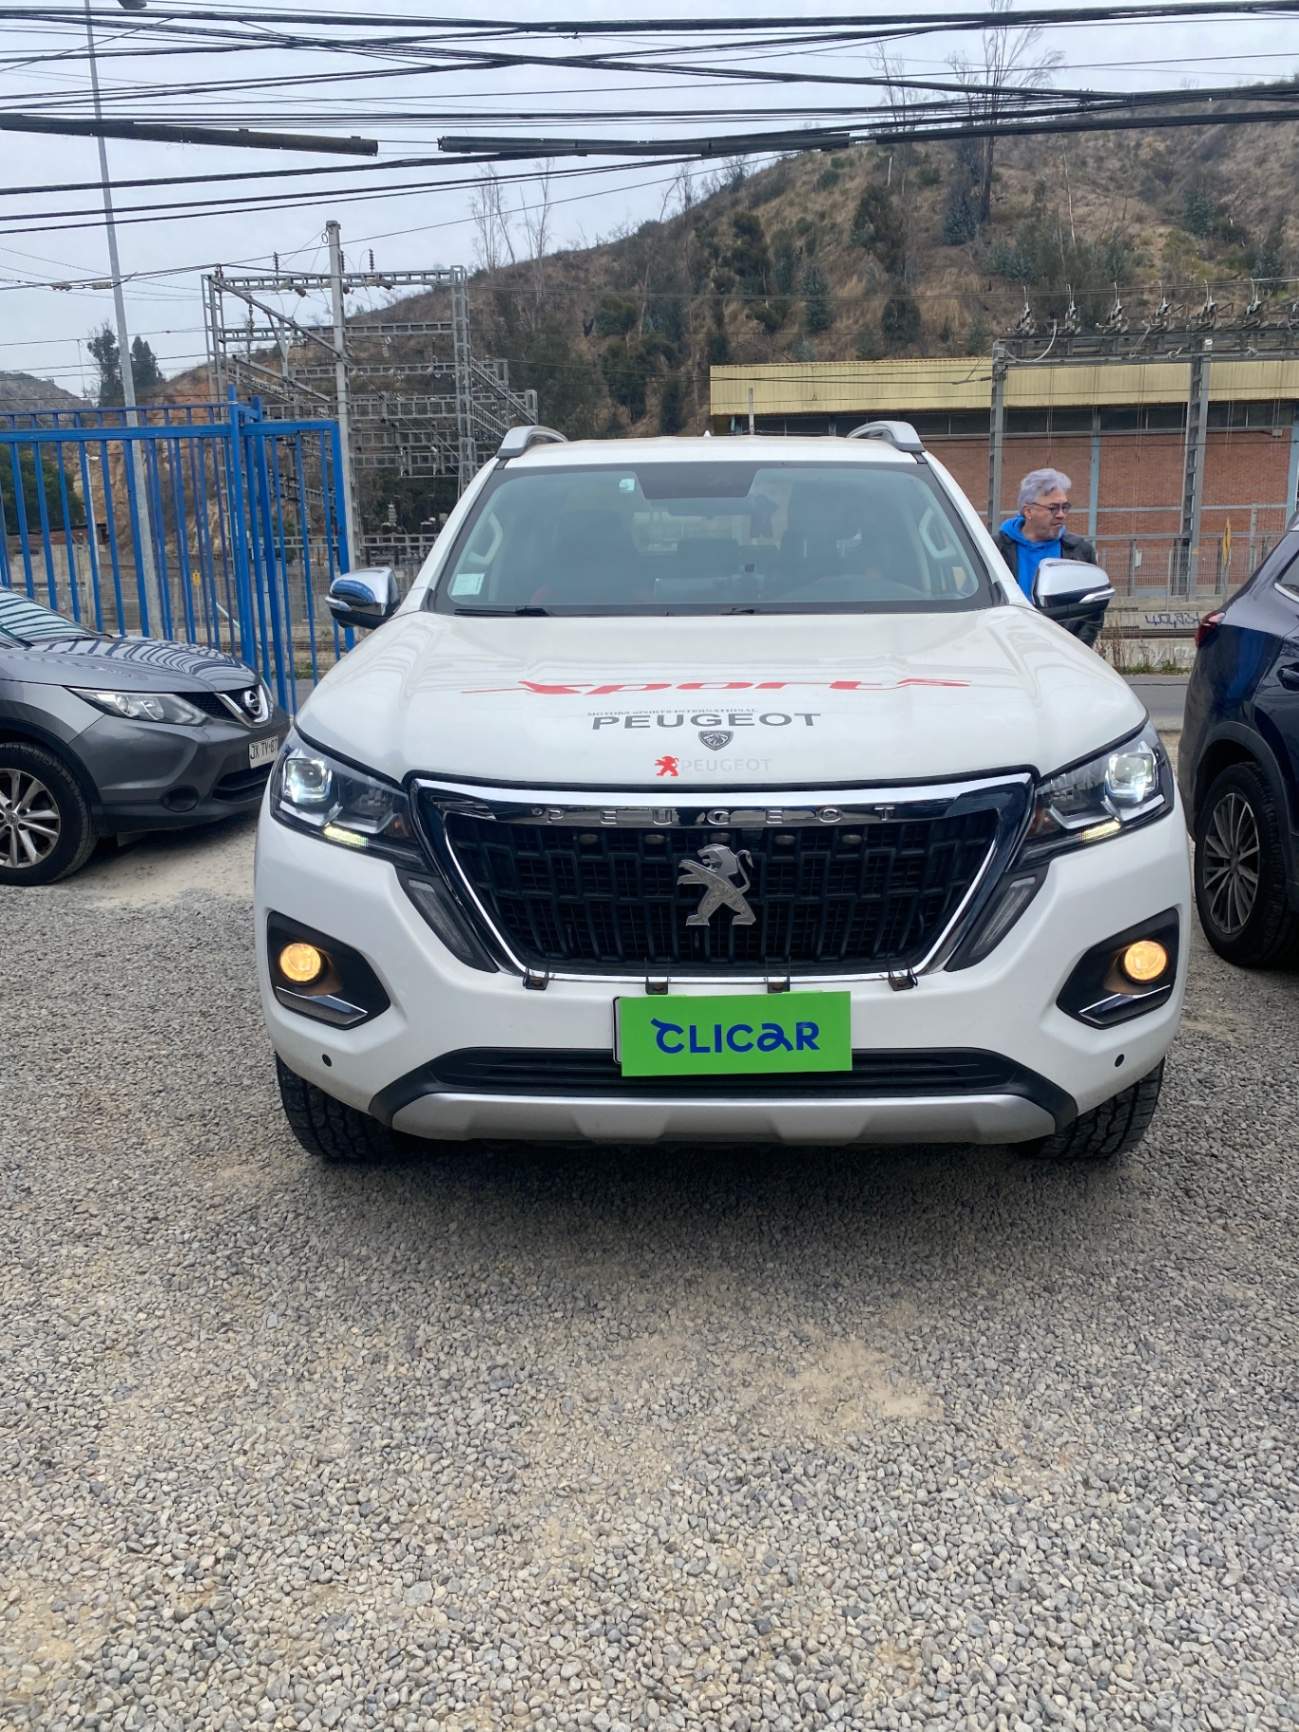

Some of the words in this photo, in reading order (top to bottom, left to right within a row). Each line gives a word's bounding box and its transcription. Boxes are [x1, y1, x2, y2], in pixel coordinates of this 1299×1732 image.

[592, 712, 821, 730] PEUGEOT
[681, 757, 772, 773] PEUGEOT
[546, 806, 895, 825] PEUGEOT
